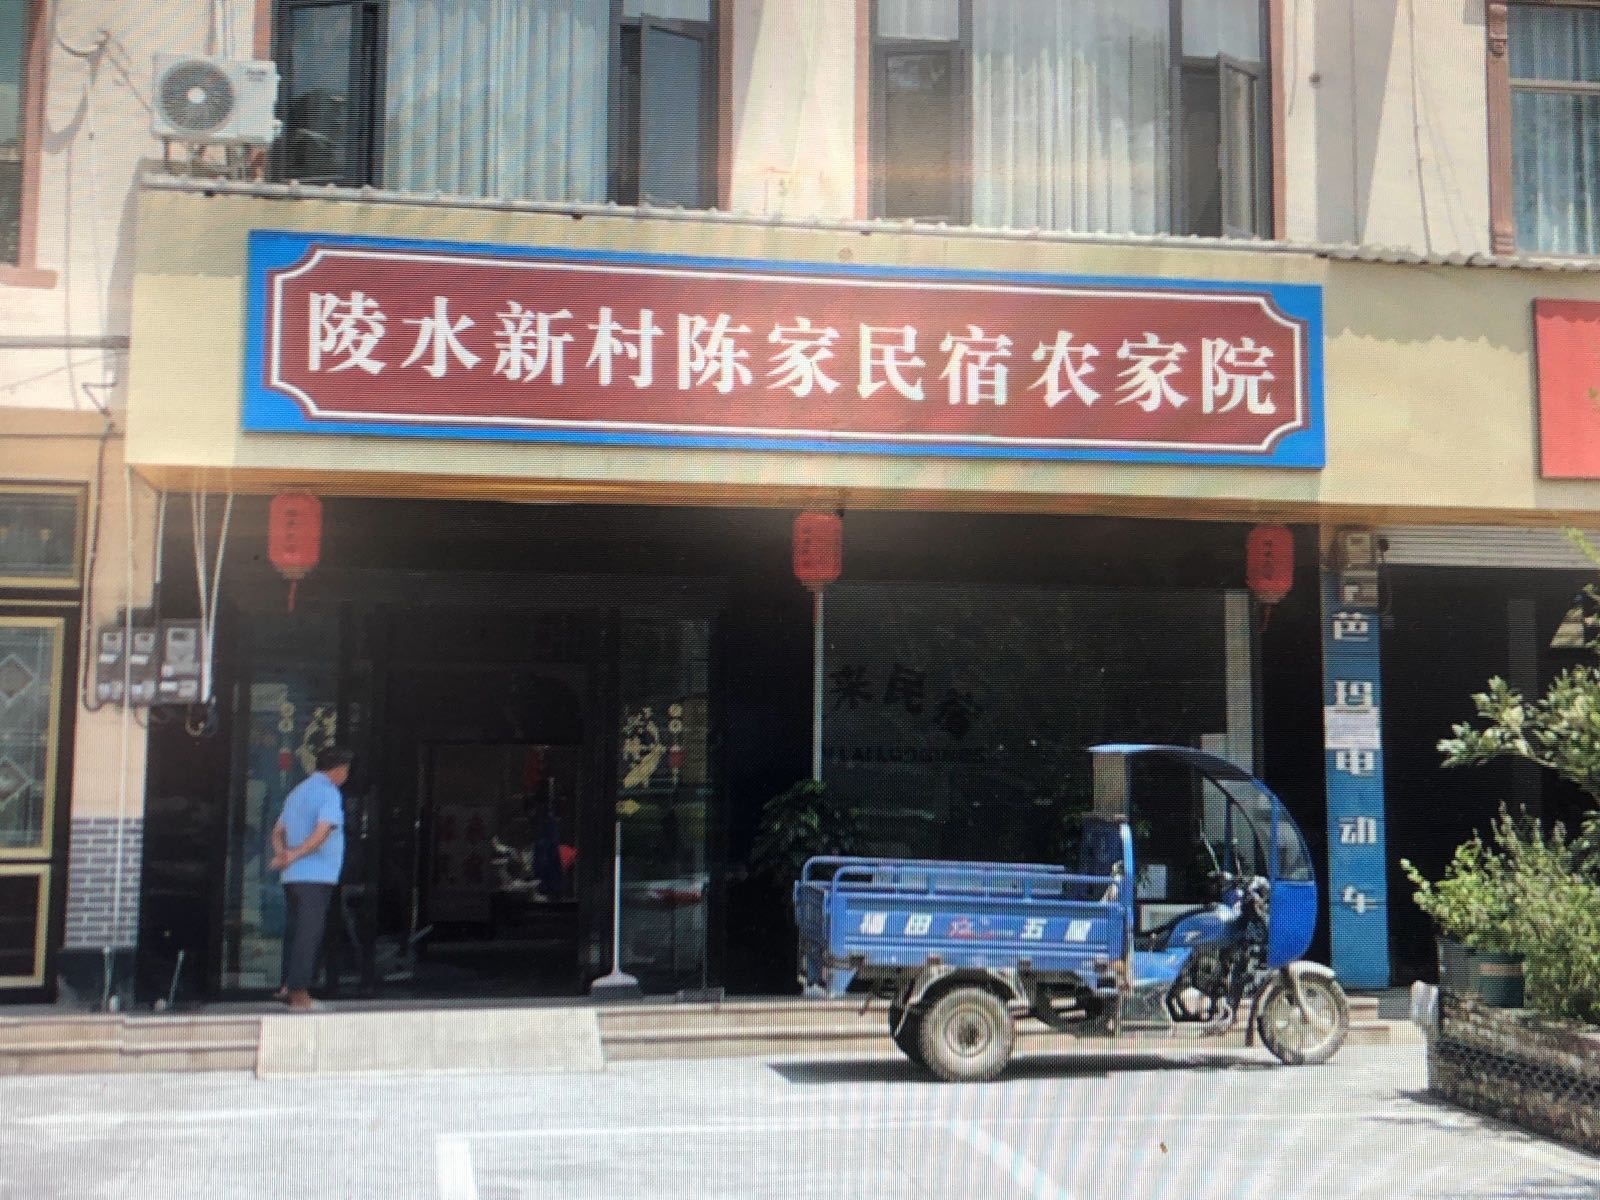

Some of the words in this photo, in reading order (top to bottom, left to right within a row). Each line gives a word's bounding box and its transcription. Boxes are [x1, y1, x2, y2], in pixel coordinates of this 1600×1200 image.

[308, 291, 1277, 416] 陵水新村陈家民宿农家院
